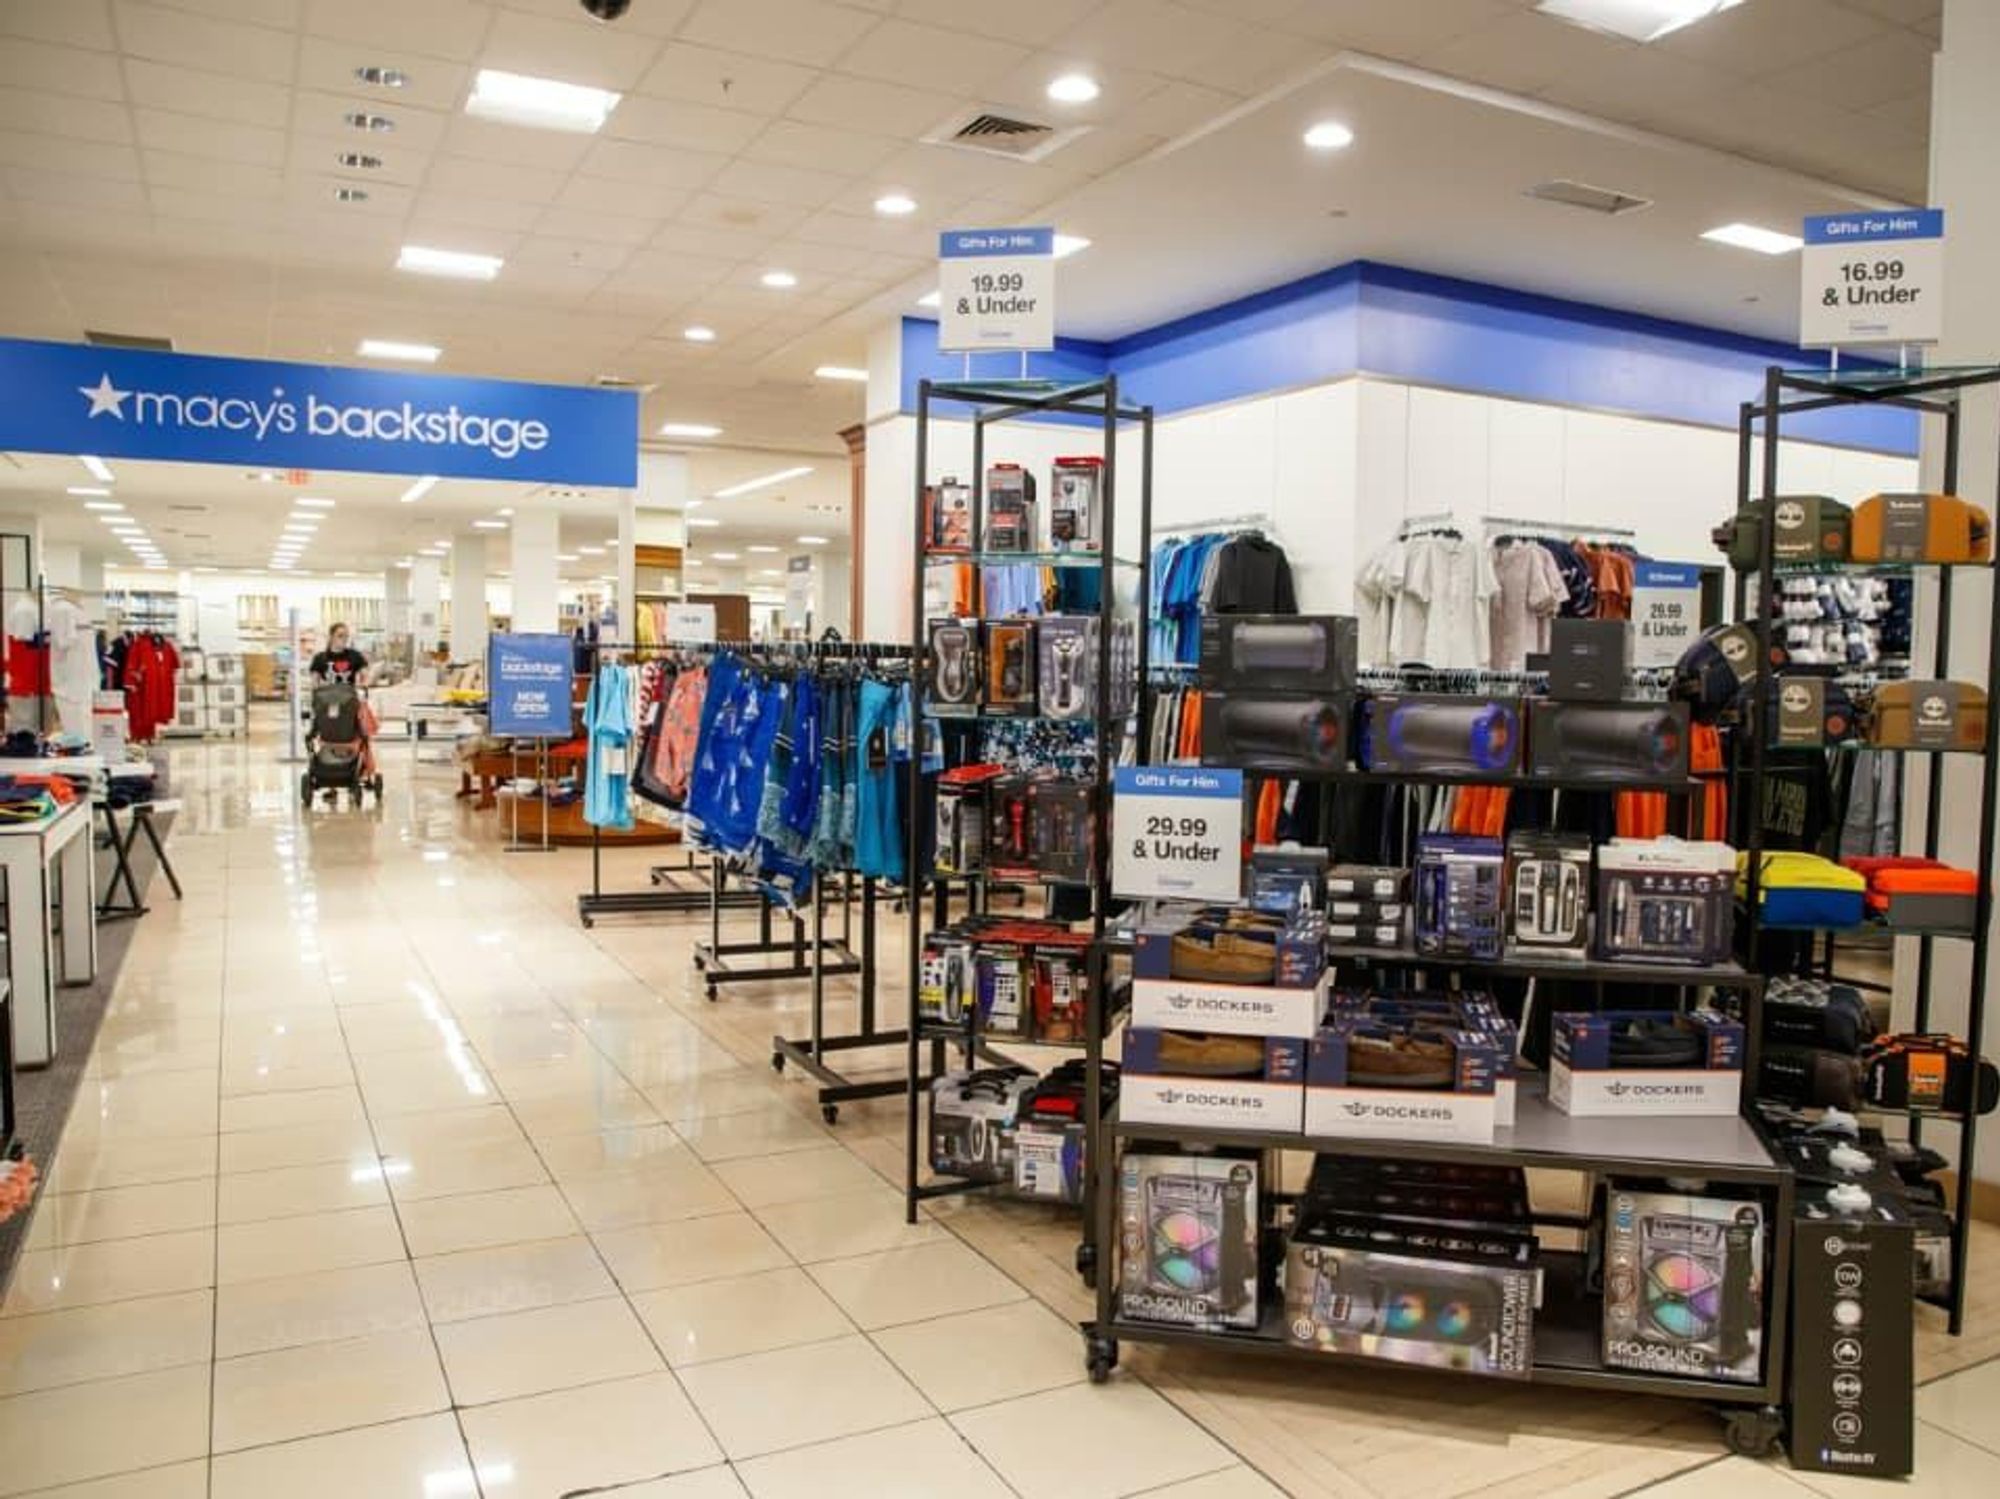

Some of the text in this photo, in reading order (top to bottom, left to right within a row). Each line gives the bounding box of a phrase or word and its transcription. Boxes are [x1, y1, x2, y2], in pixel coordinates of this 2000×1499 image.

[1826, 217, 1919, 235] Gifts For Him
[958, 235, 1035, 249] Gifts For Him
[1840, 261, 1904, 282] 16.99
[971, 274, 1024, 293] 19.99
[1822, 285, 1921, 306] & Under
[956, 295, 1037, 315] & Under
[135, 386, 549, 458] macy's backstage
[1650, 603, 1683, 619] 29.99
[1642, 622, 1688, 636] & Under
[1135, 774, 1219, 789] Gifts For Him
[1146, 816, 1207, 837] 29.99
[1132, 839, 1221, 861] & Under
[1196, 998, 1274, 1014] DOCKERS
[1633, 1084, 1705, 1095] DOCKERS
[1185, 1093, 1263, 1108] DOCKERS
[1373, 1105, 1453, 1120] DOCKERS
[1608, 1340, 1704, 1363] PRO-SOUND
